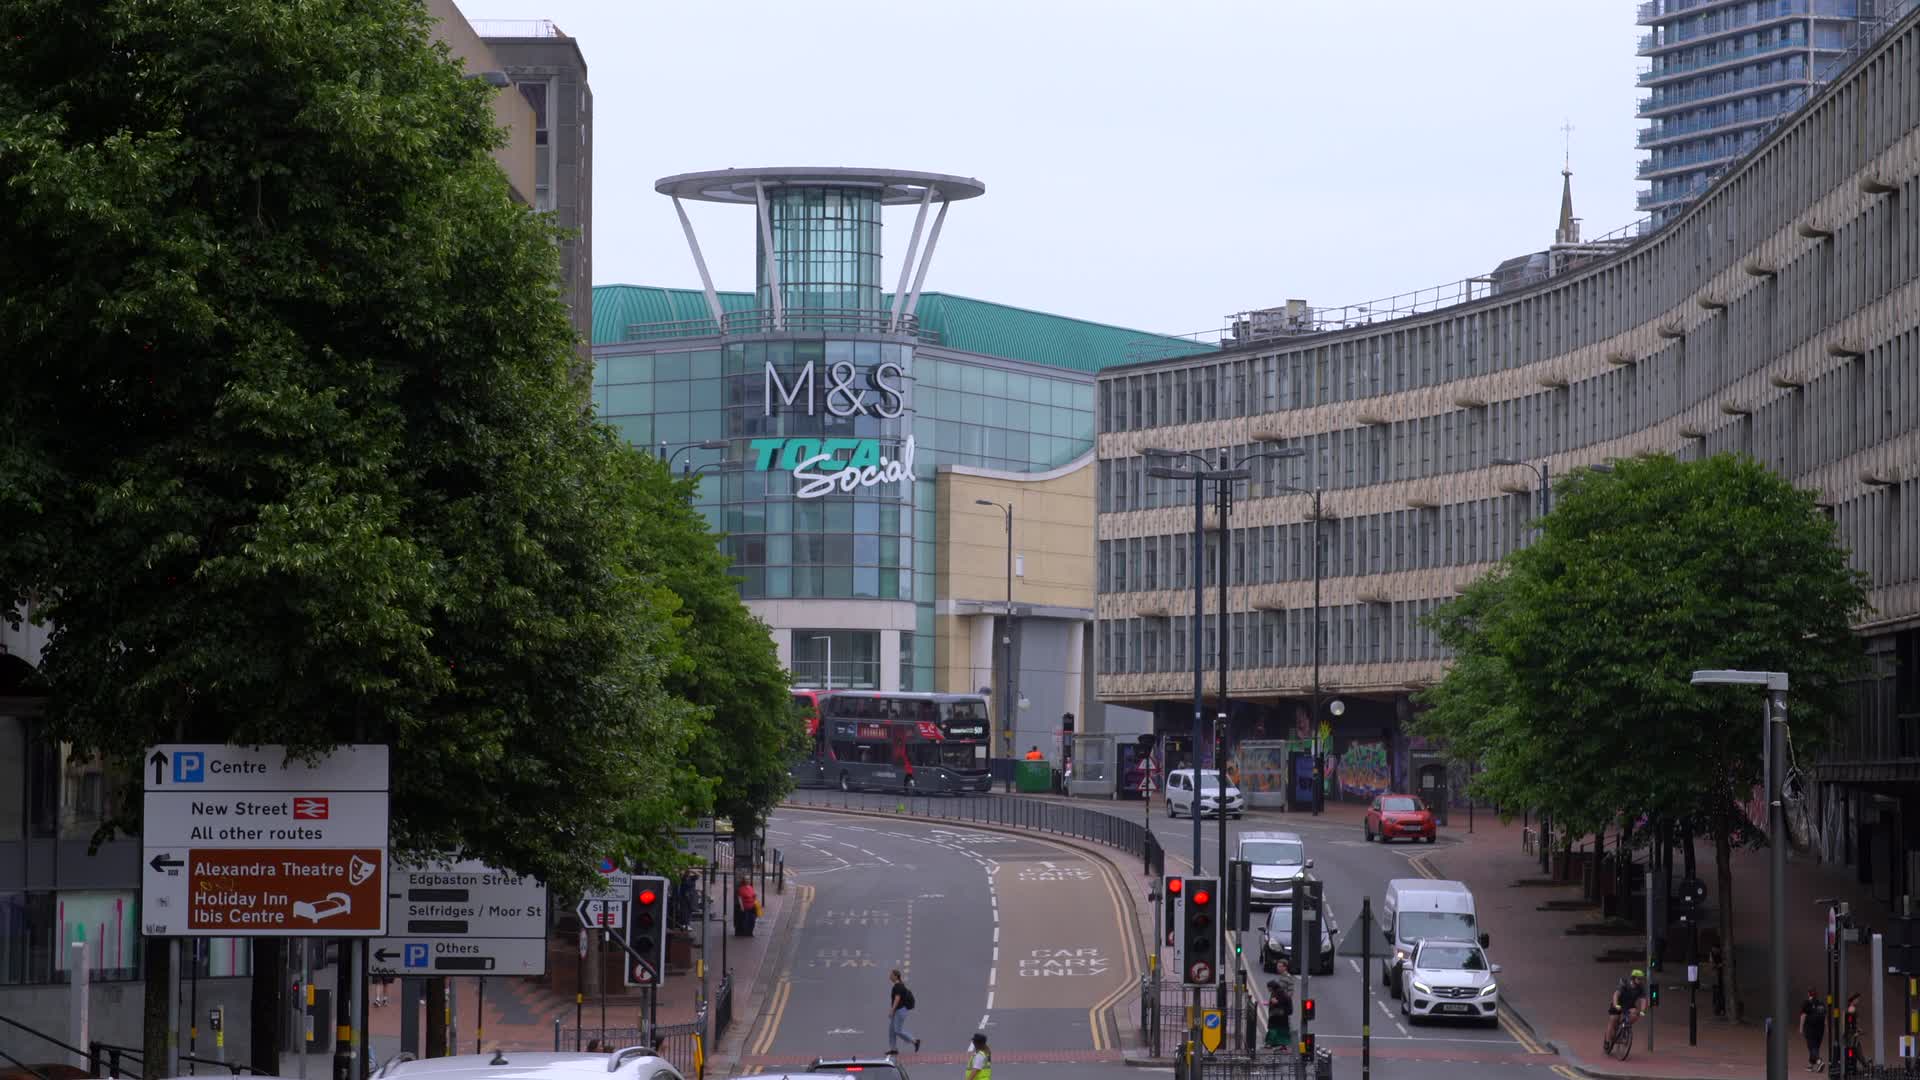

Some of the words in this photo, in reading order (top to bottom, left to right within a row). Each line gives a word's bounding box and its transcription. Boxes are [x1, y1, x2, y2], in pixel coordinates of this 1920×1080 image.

[765, 360, 904, 418] M&S
[750, 437, 880, 471] TOCA
[793, 434, 916, 498] Social
[181, 755, 200, 780] P
[209, 760, 267, 774] Centre
[191, 802, 228, 815] New
[235, 801, 288, 816] Street
[190, 826, 213, 840] All
[219, 826, 263, 840] other
[269, 827, 323, 840] routes
[194, 861, 276, 877] Alexandra
[281, 862, 344, 877] Theatre
[409, 874, 478, 887] Edgbaston
[482, 874, 524, 886] Street
[194, 891, 257, 908] Holiday
[263, 892, 288, 906] Inn
[194, 909, 223, 923] Ibis
[229, 909, 285, 923] Centre
[408, 905, 475, 918] Selfridges
[489, 906, 522, 917] Moor
[527, 906, 542, 917] St
[410, 946, 426, 967] P
[435, 942, 480, 954] Others
[1031, 949, 1097, 957] CAR
[1019, 959, 1110, 967] PARK
[1019, 968, 1109, 977] ONLY
